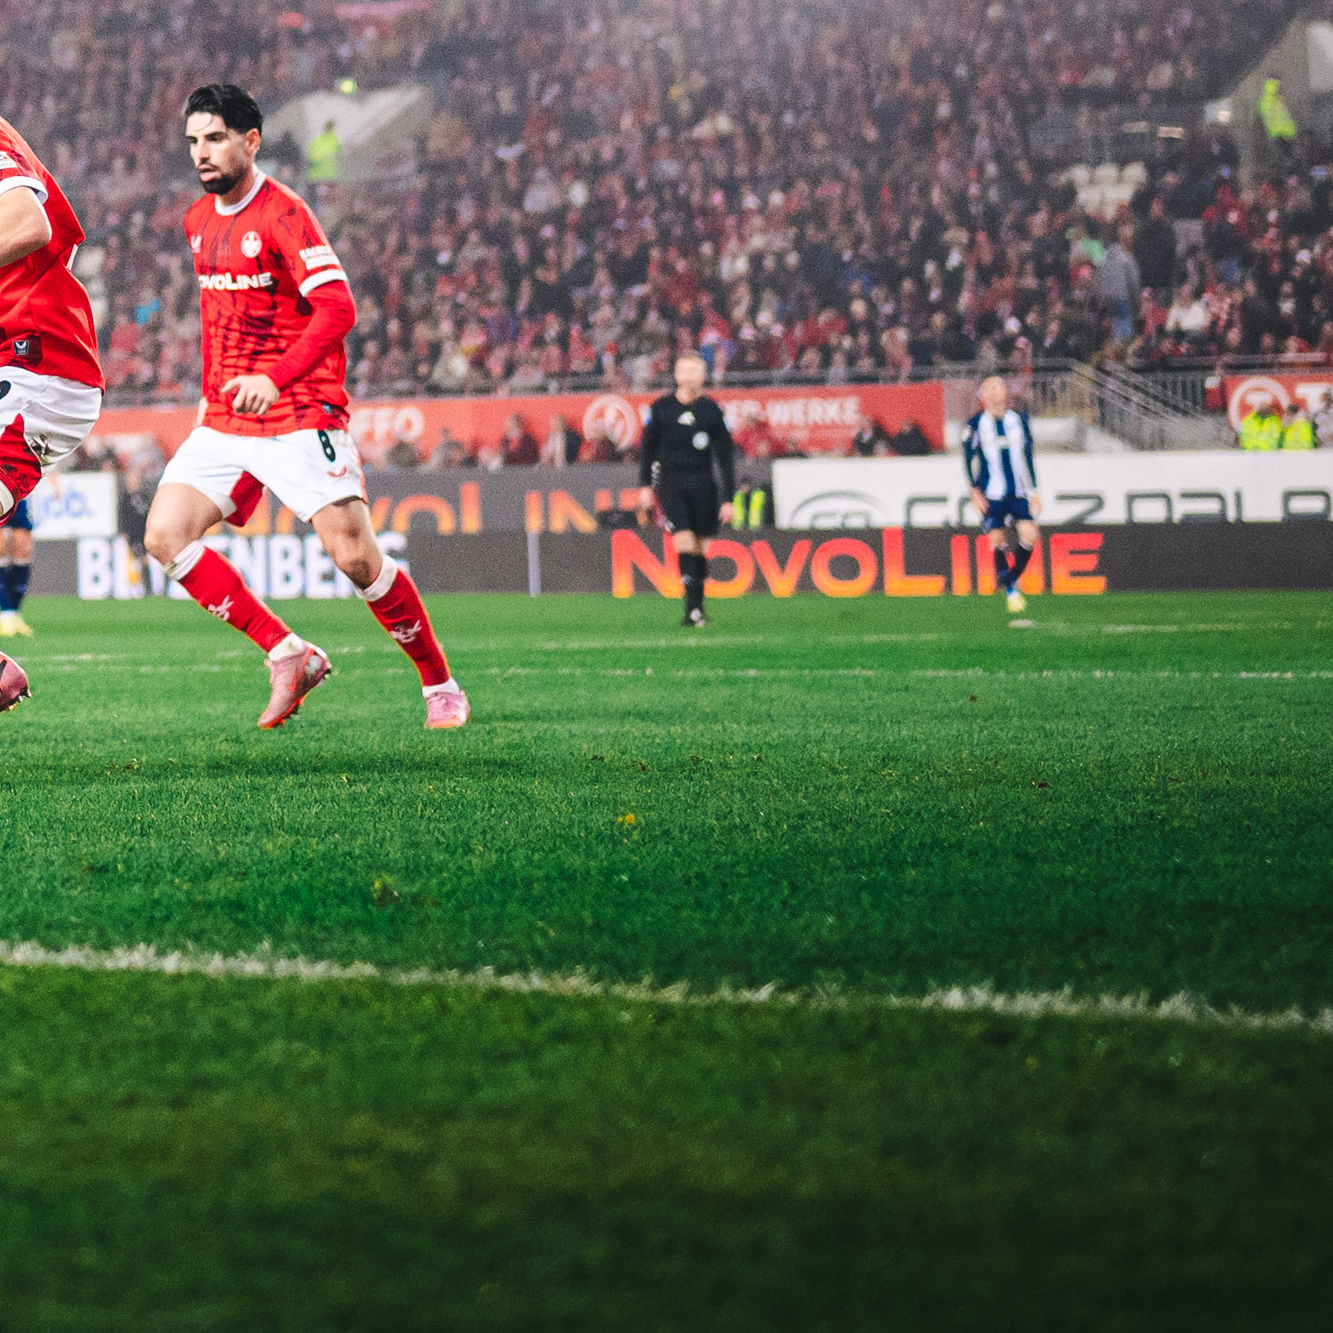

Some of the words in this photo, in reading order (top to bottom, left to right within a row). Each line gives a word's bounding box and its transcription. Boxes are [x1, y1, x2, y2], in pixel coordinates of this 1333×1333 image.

[198, 272, 273, 291] OVOLINE
[317, 430, 336, 463] 8
[611, 528, 1108, 598] NOVOLINE
